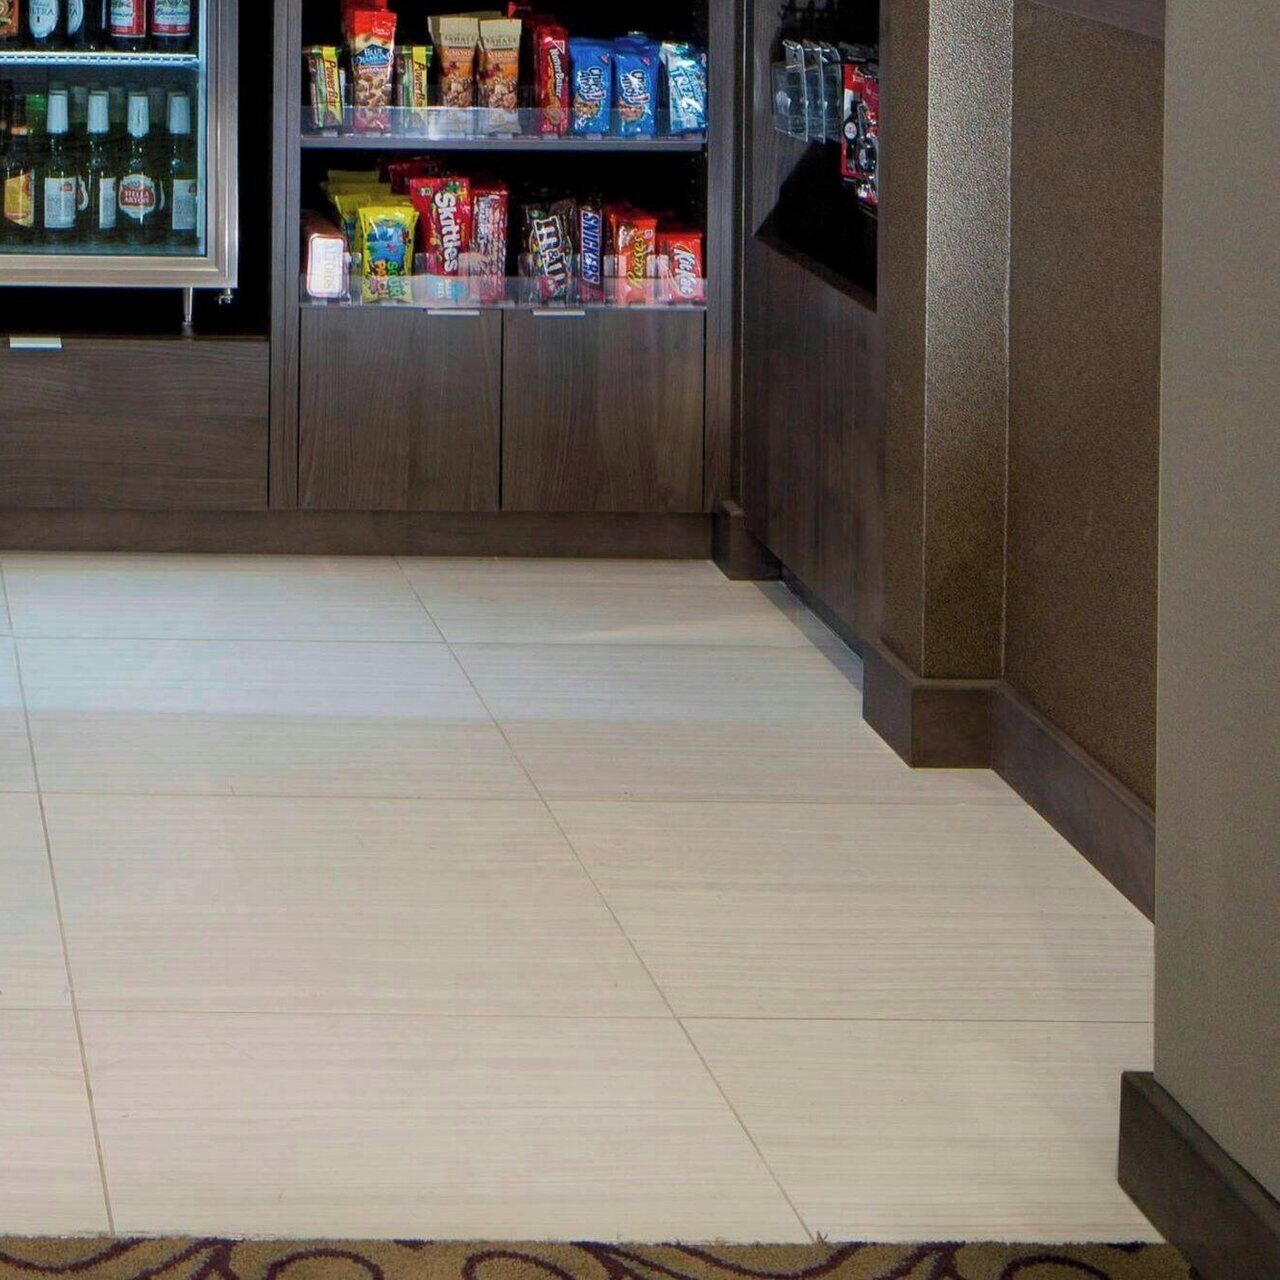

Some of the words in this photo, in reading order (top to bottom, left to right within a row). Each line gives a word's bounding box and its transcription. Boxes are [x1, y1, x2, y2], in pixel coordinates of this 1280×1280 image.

[326, 60, 338, 107] PowerBar
[415, 60, 426, 107] PowerBa
[434, 192, 461, 272] Skittles
[583, 213, 600, 284] SNICKERS
